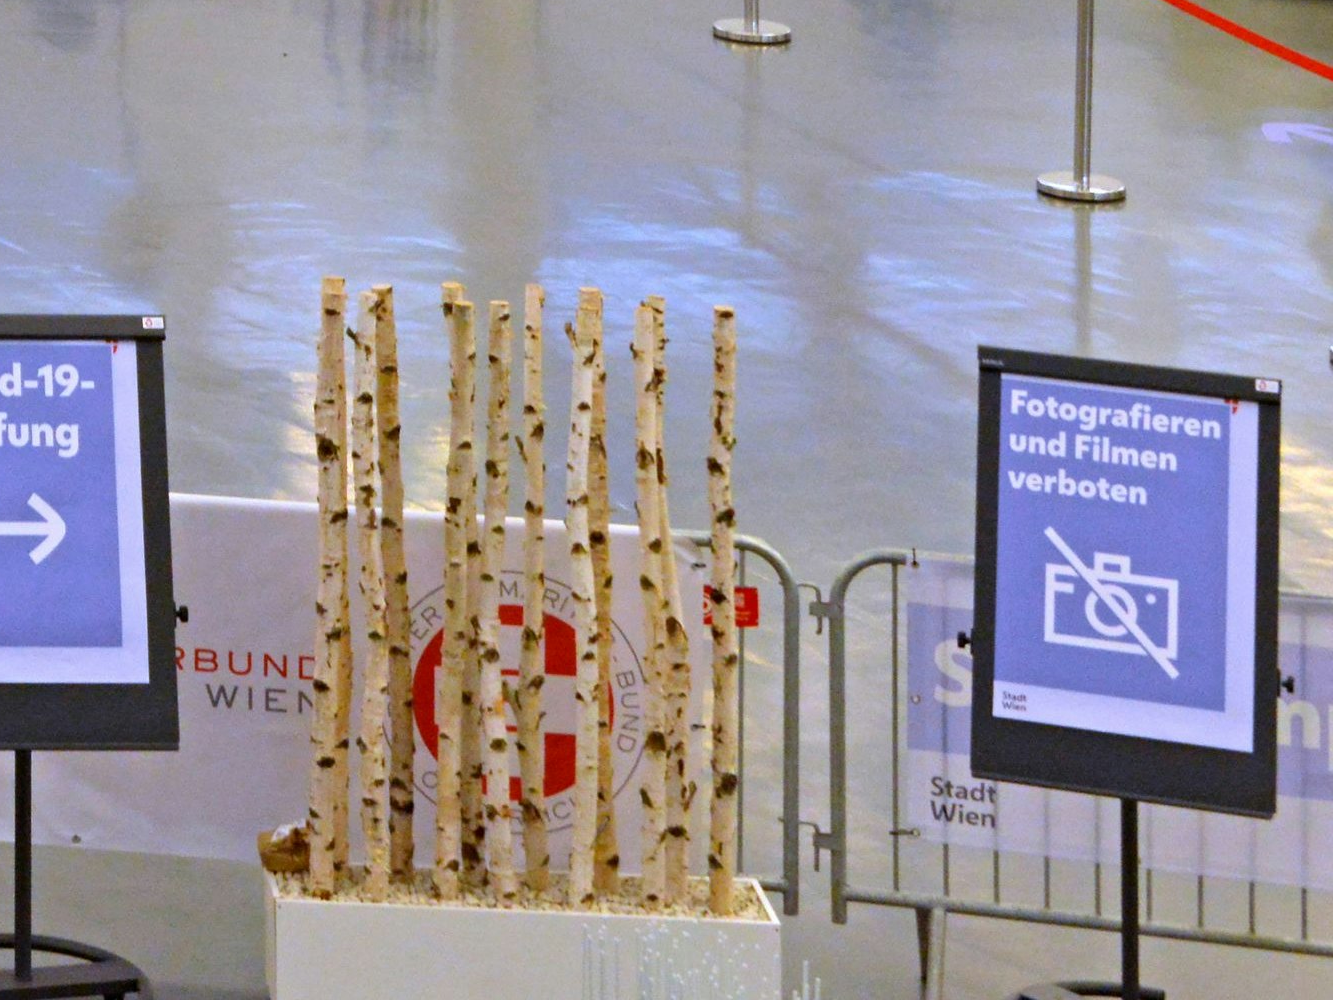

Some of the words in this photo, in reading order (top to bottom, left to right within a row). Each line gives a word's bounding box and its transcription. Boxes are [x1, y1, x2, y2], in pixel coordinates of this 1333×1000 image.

[1010, 388, 1222, 440] Fotografieren
[1008, 430, 1067, 458] und
[1074, 433, 1178, 472] Filmen
[1007, 468, 1148, 507] verboten
[614, 669, 641, 753] BUND
[1001, 701, 1028, 713] Wien
[1002, 690, 1028, 703] Stadt
[931, 776, 997, 803] Stadt
[930, 800, 997, 828] Wien
